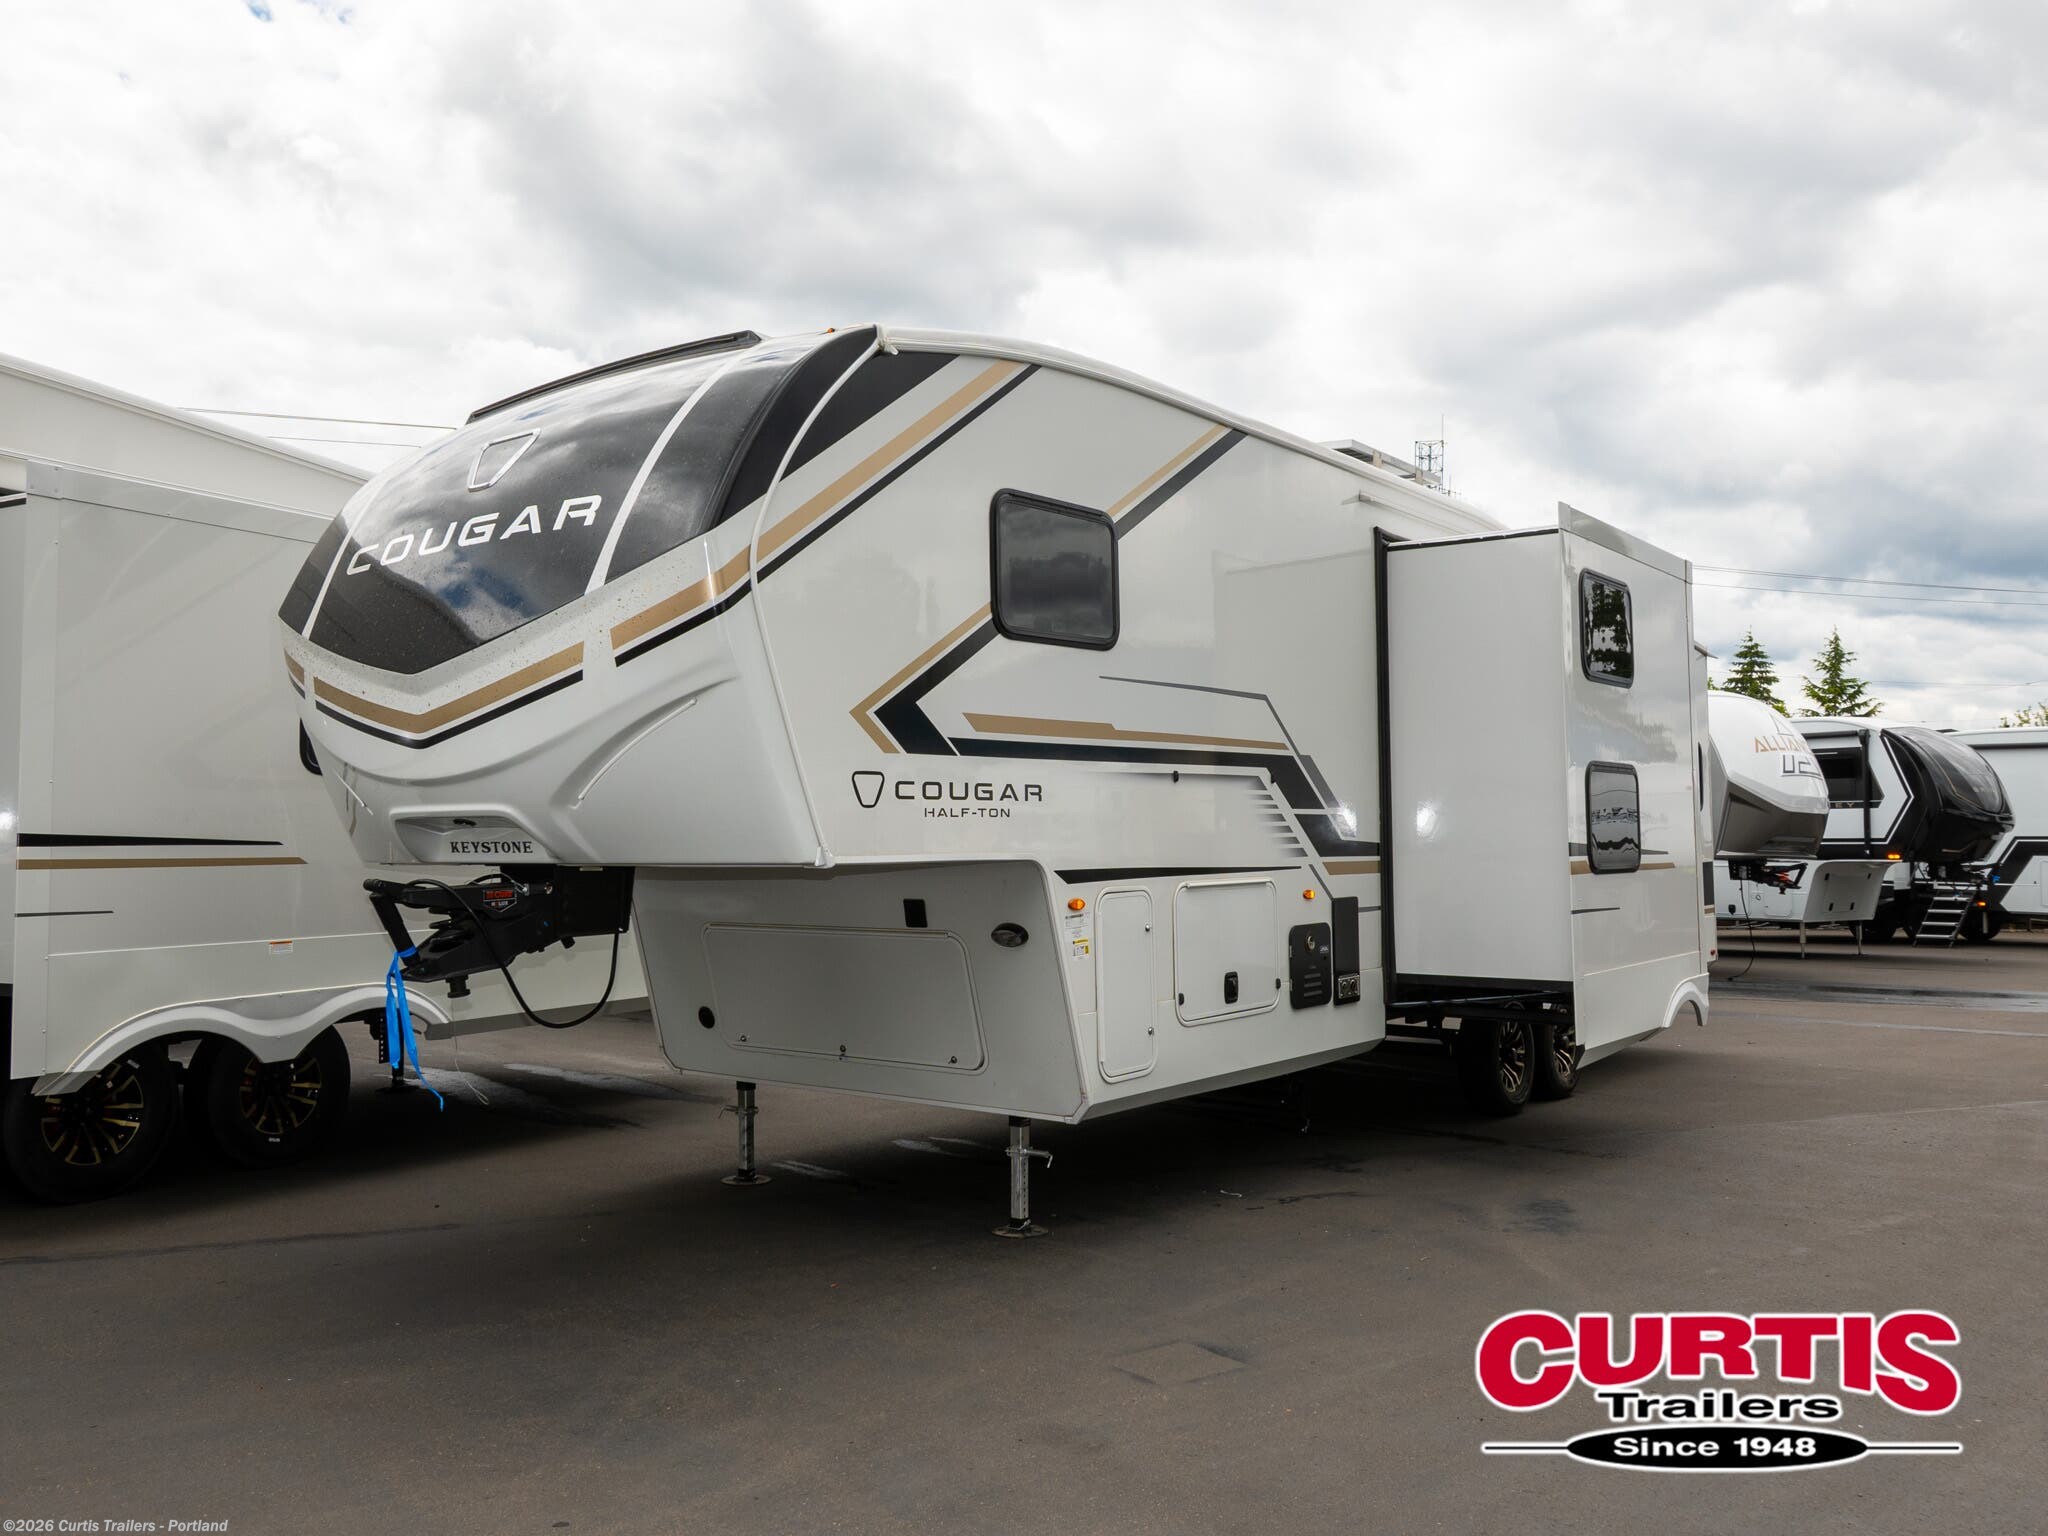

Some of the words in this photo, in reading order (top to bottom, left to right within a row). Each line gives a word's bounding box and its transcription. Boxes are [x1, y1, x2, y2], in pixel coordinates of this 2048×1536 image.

[346, 494, 602, 576] COUGAR
[894, 780, 1043, 802] COUGAR
[924, 807, 1011, 818] HALF-TON
[450, 841, 533, 854] KEYSTONE
